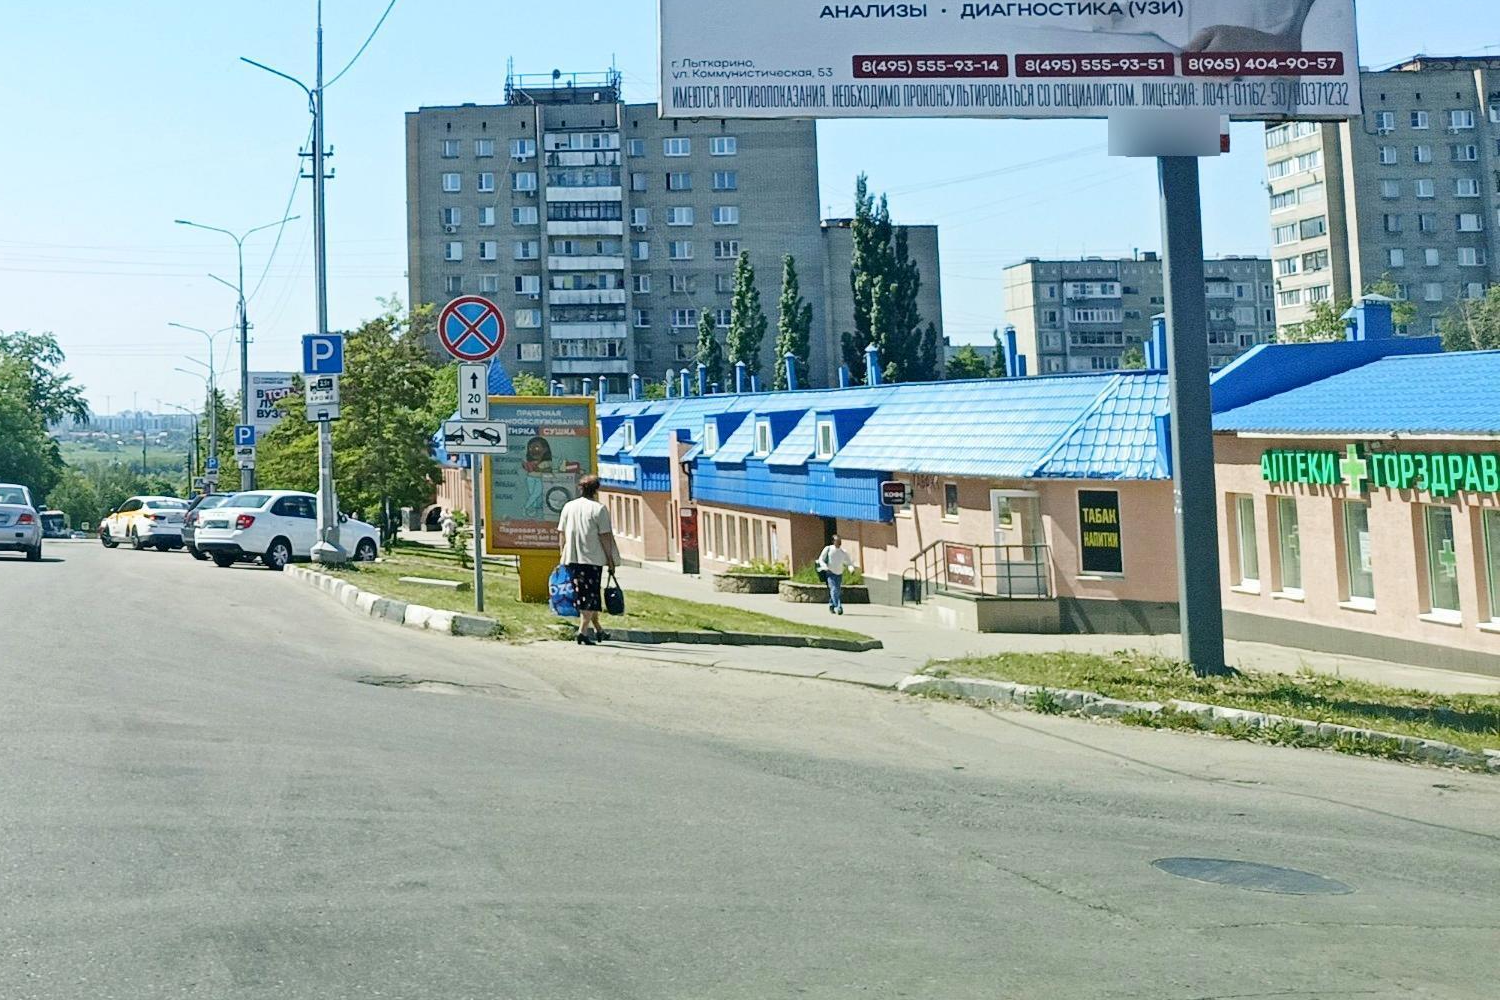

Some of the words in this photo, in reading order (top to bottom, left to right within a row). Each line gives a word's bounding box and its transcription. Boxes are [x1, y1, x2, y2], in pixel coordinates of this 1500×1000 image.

[819, 3, 928, 19] АНАЛИЗЫ
[960, 1, 1124, 18] ДИАГНОСТИКА
[1128, 0, 1184, 18] (УЗИ)
[671, 60, 679, 68] г.
[681, 58, 755, 69] Лыткарино,
[861, 59, 913, 74] 8(495)
[915, 58, 999, 73] 555-93-14
[1025, 58, 1077, 73] 8(495)
[1080, 57, 1166, 72] 555-93-51
[1188, 57, 1241, 72] 8(965)
[1244, 56, 1337, 71] 404-90-57
[672, 71, 689, 79] ул.
[692, 68, 815, 79] Коммунистическая,
[817, 67, 833, 77] 53
[672, 85, 720, 109] ИМЕЮТСЯ
[722, 85, 828, 108] ПРОТИВОПОКАЗАНИЯ.
[832, 84, 901, 109] НЕОБХОДИМО
[903, 83, 1034, 108] ПРОКОНСУЛЬТИРОВАТЬСЯ
[1036, 83, 1050, 107] СО
[1053, 82, 1139, 109] СПЕЦИАЛИСТОМ.
[1141, 82, 1199, 109] ЛИЦЕНЗИЯ:
[311, 338, 334, 371] P
[467, 393, 481, 404] 20
[543, 427, 576, 436] СУШКА
[1260, 452, 1337, 485] АПТЕКИ
[1372, 453, 1500, 498] ГОРЗДРАВ
